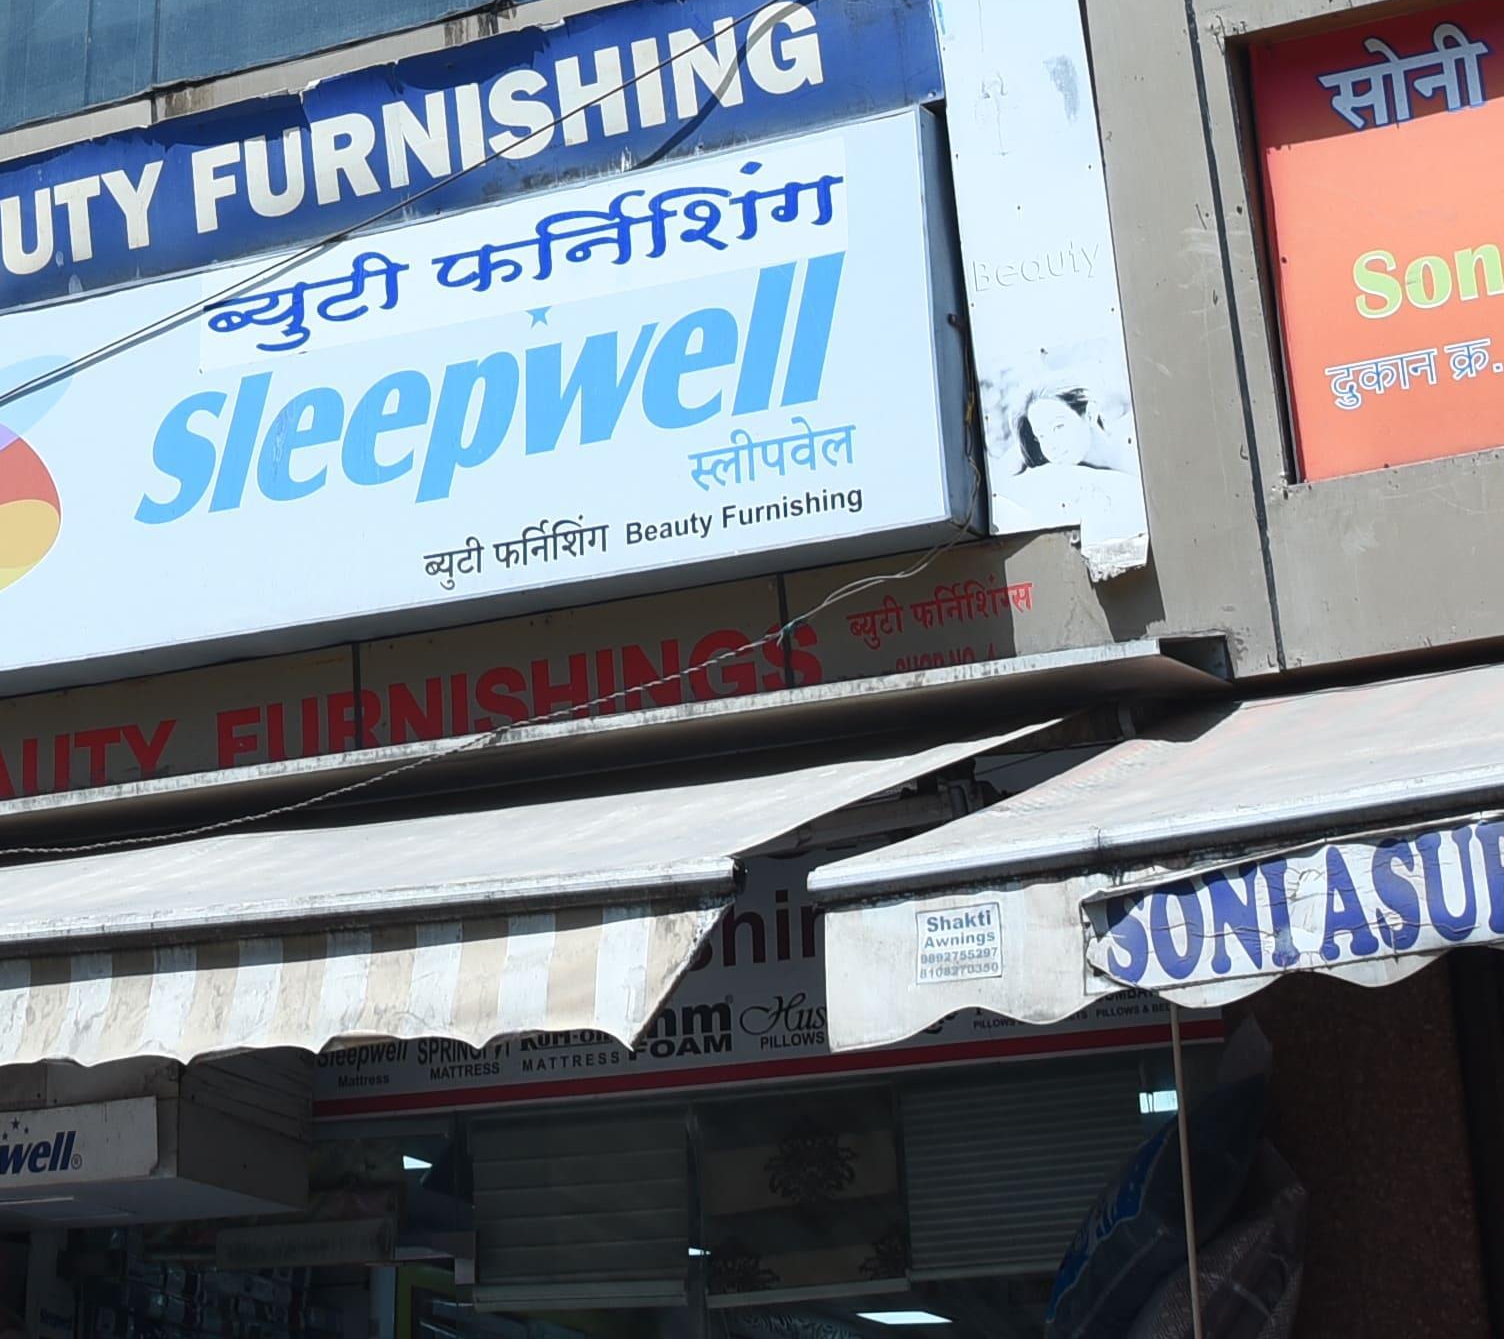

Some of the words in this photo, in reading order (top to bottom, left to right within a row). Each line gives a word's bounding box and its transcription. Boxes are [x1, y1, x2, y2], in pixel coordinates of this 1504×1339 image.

[1317, 23, 1491, 132] सोनी
[192, 1, 824, 234] FURNISHING
[206, 251, 410, 351] ब्युटी
[431, 160, 844, 293] फर्निशिंग
[134, 251, 847, 524] Sleepwell
[1326, 341, 1438, 413] दुकान
[688, 415, 857, 492] स्लीपवेल
[423, 538, 485, 591] ब्युटी
[492, 514, 609, 569] फर्निशिंग
[626, 509, 713, 547] Beauty
[722, 485, 863, 531] Furnishing
[217, 626, 822, 767] FURNISHINGS
[923, 926, 996, 950] Awnings
[926, 909, 992, 934] Shakti
[1106, 849, 1294, 984] SONI
[629, 1034, 732, 1061] FOAM
[760, 1032, 824, 1049] PILLOWS
[1096, 1006, 1140, 1018] PILLOWS
[338, 1073, 389, 1088] Mattress
[430, 1062, 500, 1081] MATTRESS
[522, 1052, 619, 1072] MATTRESS
